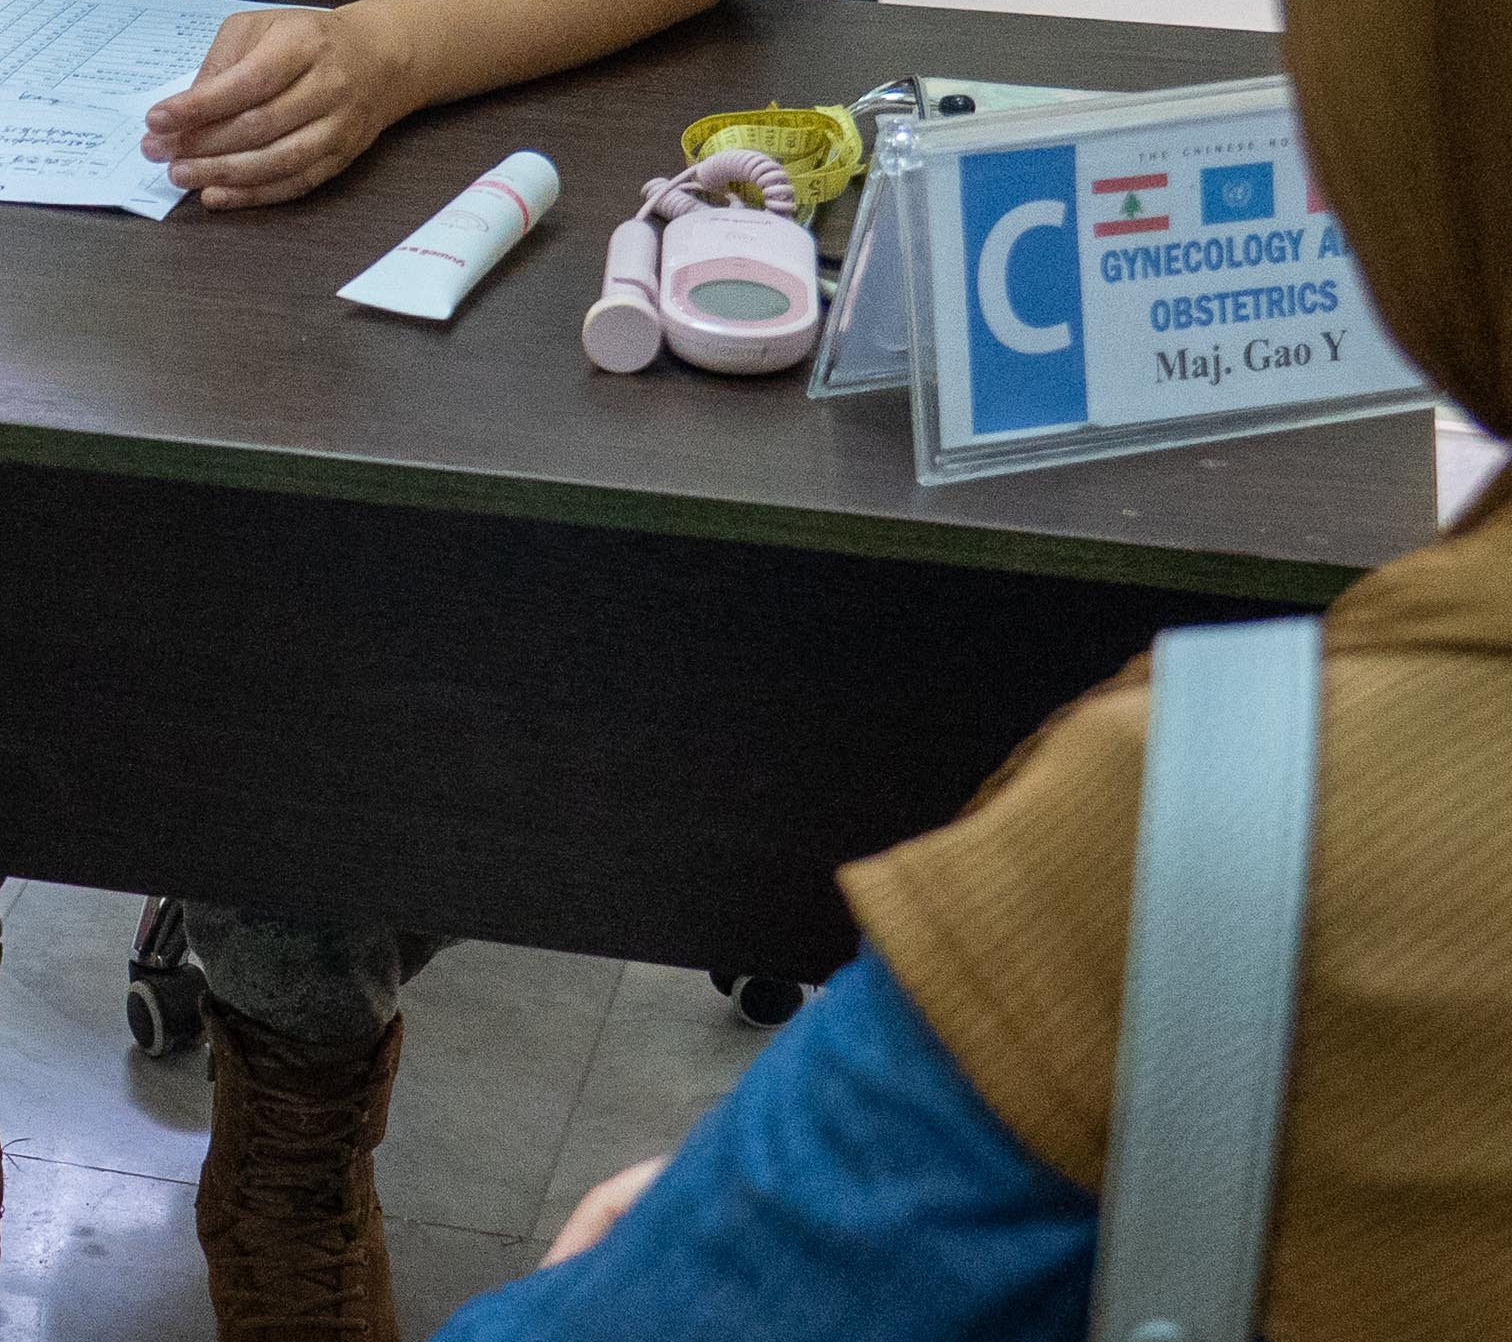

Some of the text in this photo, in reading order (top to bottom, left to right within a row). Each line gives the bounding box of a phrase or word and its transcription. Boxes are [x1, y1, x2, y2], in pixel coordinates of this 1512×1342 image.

[1139, 137, 1290, 163] THE CHINESE HO
[977, 199, 1072, 355] C
[1100, 225, 1344, 284] GYNECOLOGY A
[1151, 279, 1338, 333] OBSTETRICS
[1155, 329, 1347, 386] Maj. Gao Y
